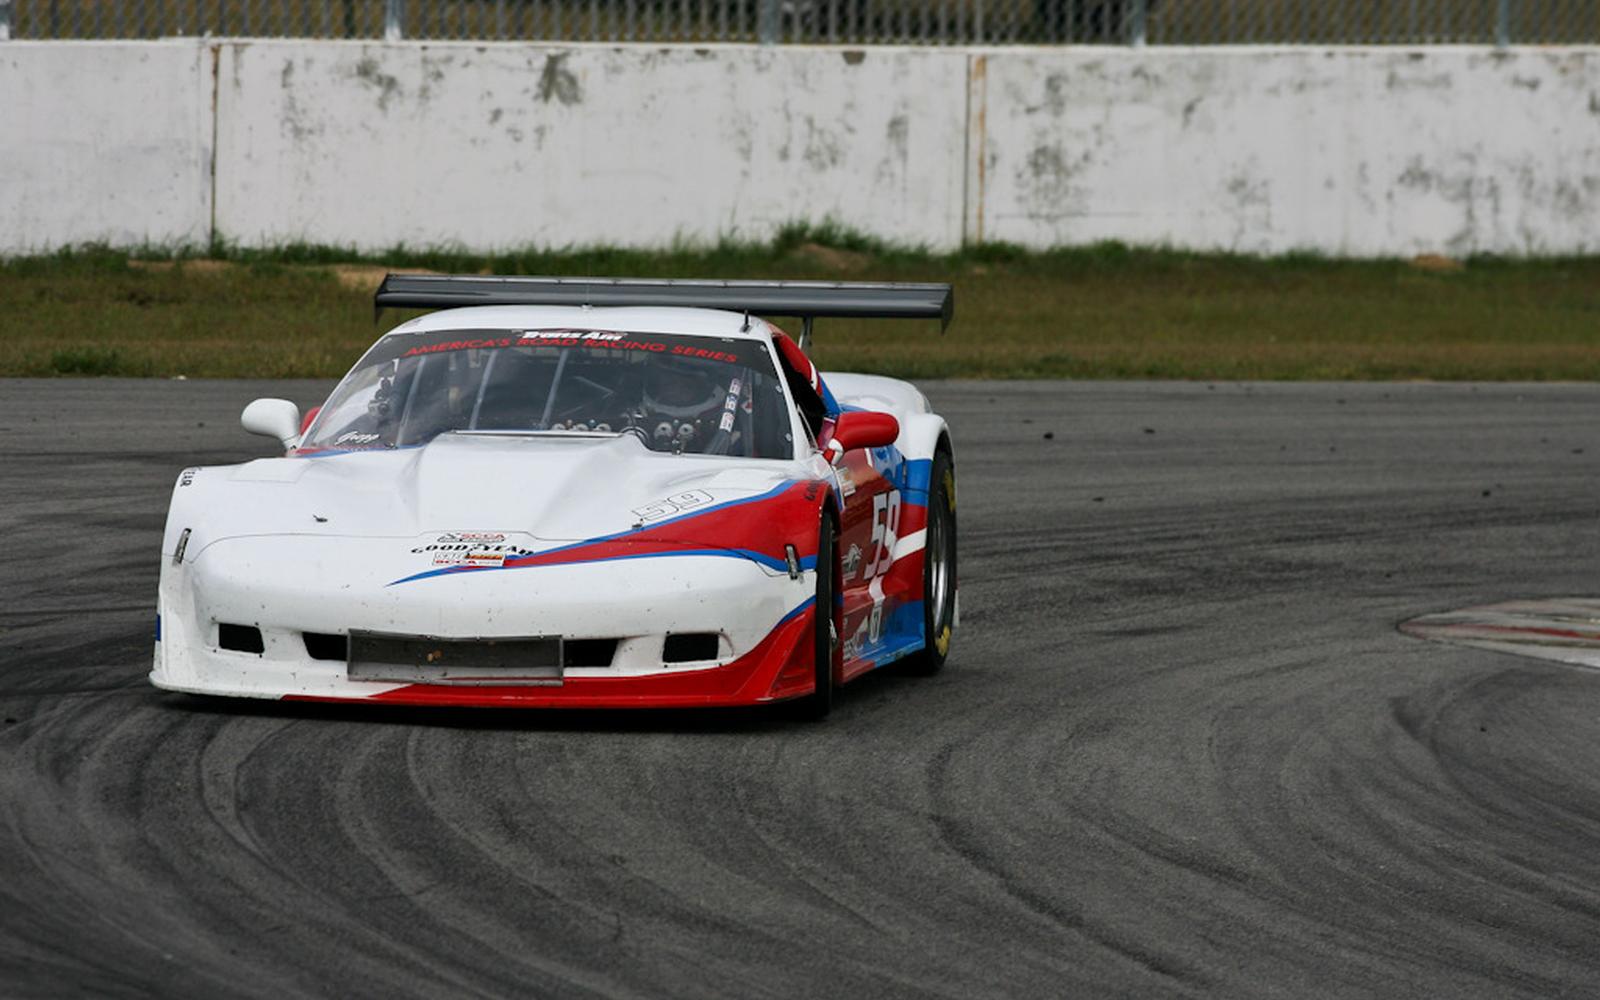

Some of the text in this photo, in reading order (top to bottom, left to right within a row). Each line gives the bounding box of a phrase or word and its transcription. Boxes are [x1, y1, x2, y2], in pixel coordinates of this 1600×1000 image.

[403, 337, 738, 363] AMERICA'S ROAD RACING SERIES
[631, 489, 715, 521] 59
[863, 488, 902, 580] 59
[411, 543, 534, 556] GOODYEAR
